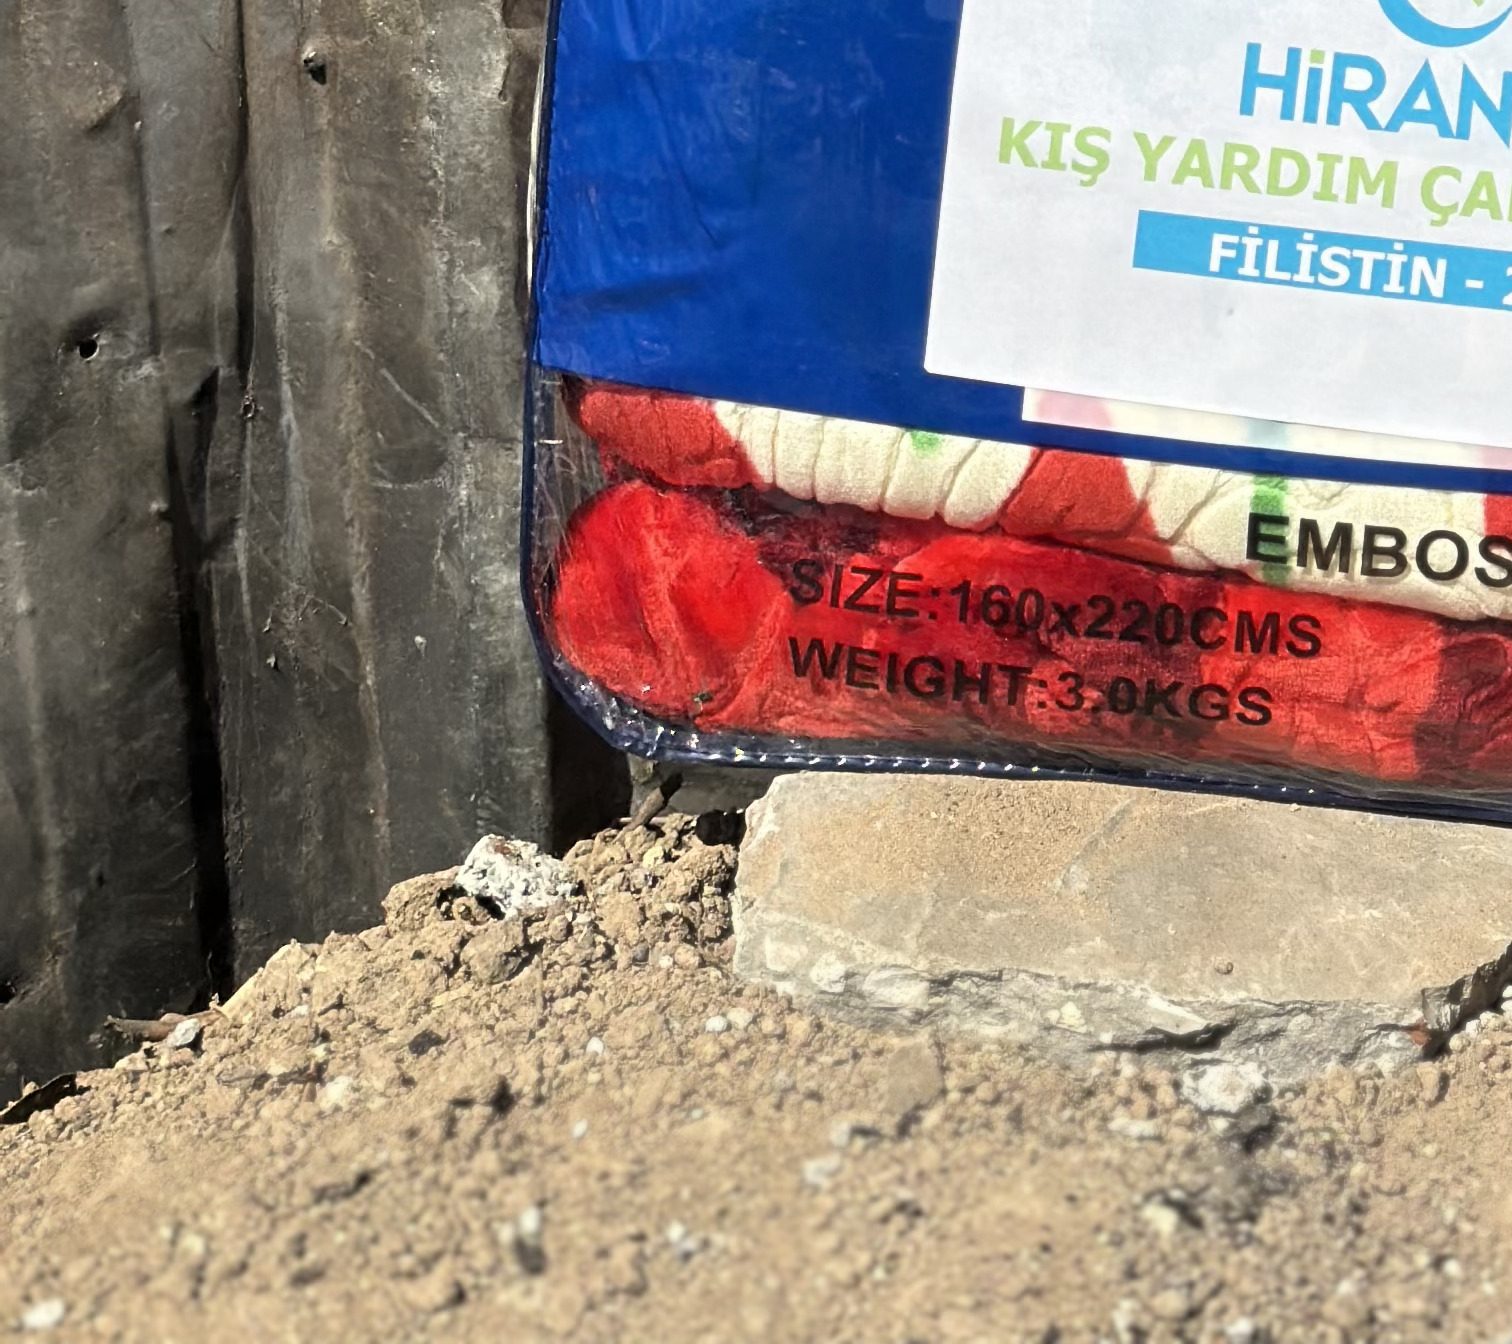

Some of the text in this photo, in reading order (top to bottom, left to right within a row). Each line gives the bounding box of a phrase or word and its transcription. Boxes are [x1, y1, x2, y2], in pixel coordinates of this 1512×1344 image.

[999, 116, 1113, 188] KIŞ
[1132, 130, 1400, 210] YARDIM
[1208, 226, 1448, 299] FİLİSTİN
